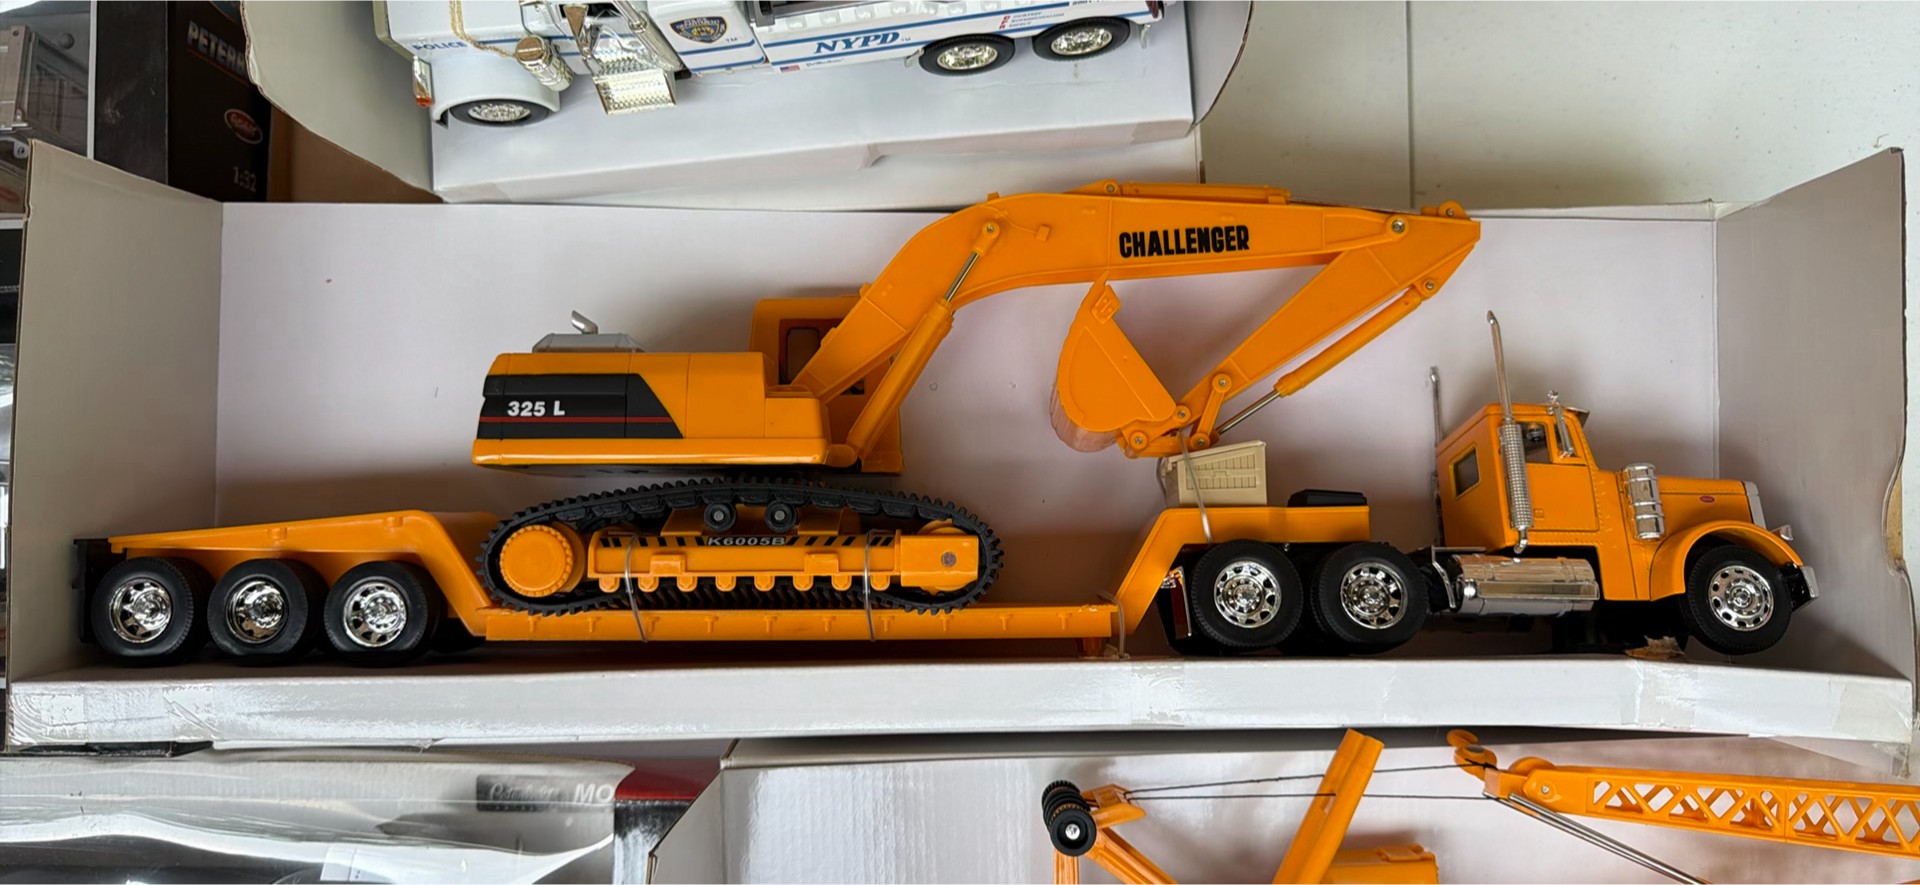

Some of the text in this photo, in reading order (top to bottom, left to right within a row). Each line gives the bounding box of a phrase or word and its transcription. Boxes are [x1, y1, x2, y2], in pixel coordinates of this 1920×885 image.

[412, 41, 468, 50] POLICE
[813, 31, 900, 54] NYPD
[233, 166, 257, 192] 1:32
[1119, 225, 1250, 258] CHALLENGER
[507, 400, 566, 417] 325 L
[707, 537, 786, 546] K6005B
